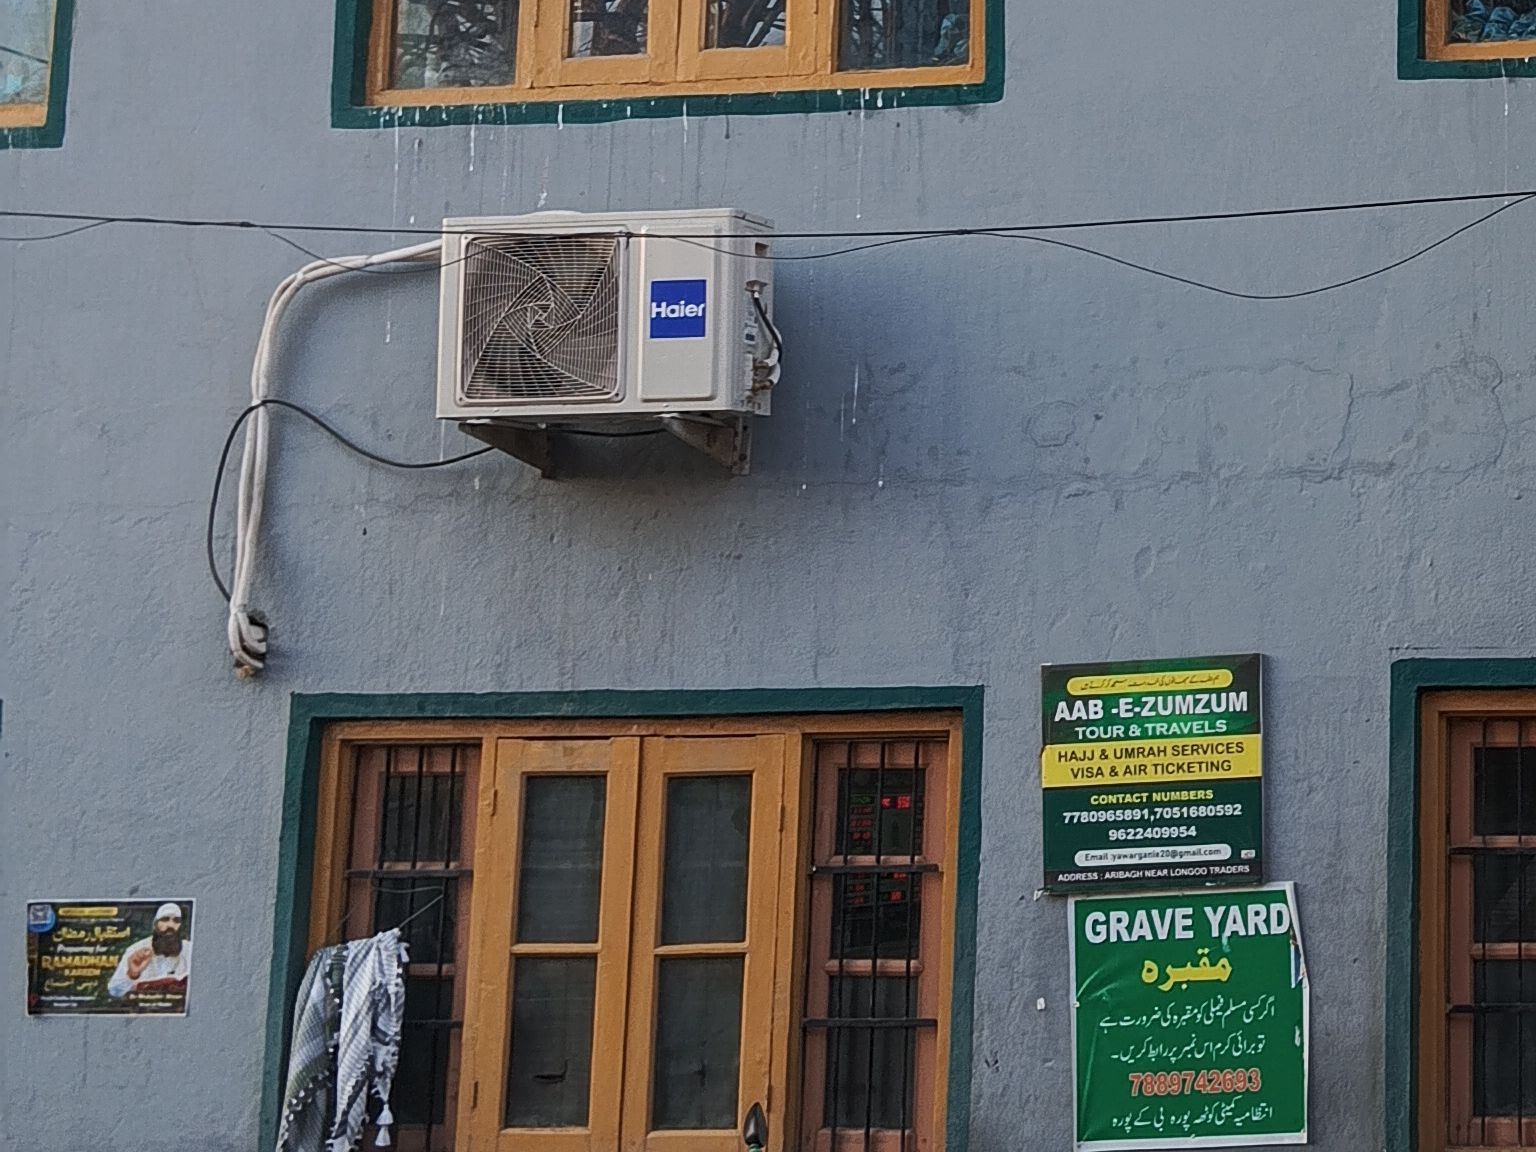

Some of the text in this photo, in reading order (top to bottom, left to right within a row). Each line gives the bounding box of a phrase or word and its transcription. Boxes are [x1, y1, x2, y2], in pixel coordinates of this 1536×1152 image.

[651, 300, 705, 318] Haier
[1054, 700, 1104, 722] AAB
[1075, 720, 1227, 739] TOUR & TRAVELS
[1058, 741, 1244, 763] HAJJ & UMRAH SERVICES
[1071, 760, 1232, 779] VISA & AIR TICKETING
[1091, 790, 1213, 805] CONTACT NUMBERS
[1109, 826, 1197, 841] 9622409954
[1145, 868, 1168, 878] NEAR
[1209, 865, 1250, 874] TRADERS
[1085, 903, 1291, 943] GRAVE YARD
[1142, 948, 1232, 991] مقبرہ
[1129, 1068, 1261, 1097] 7889742693
